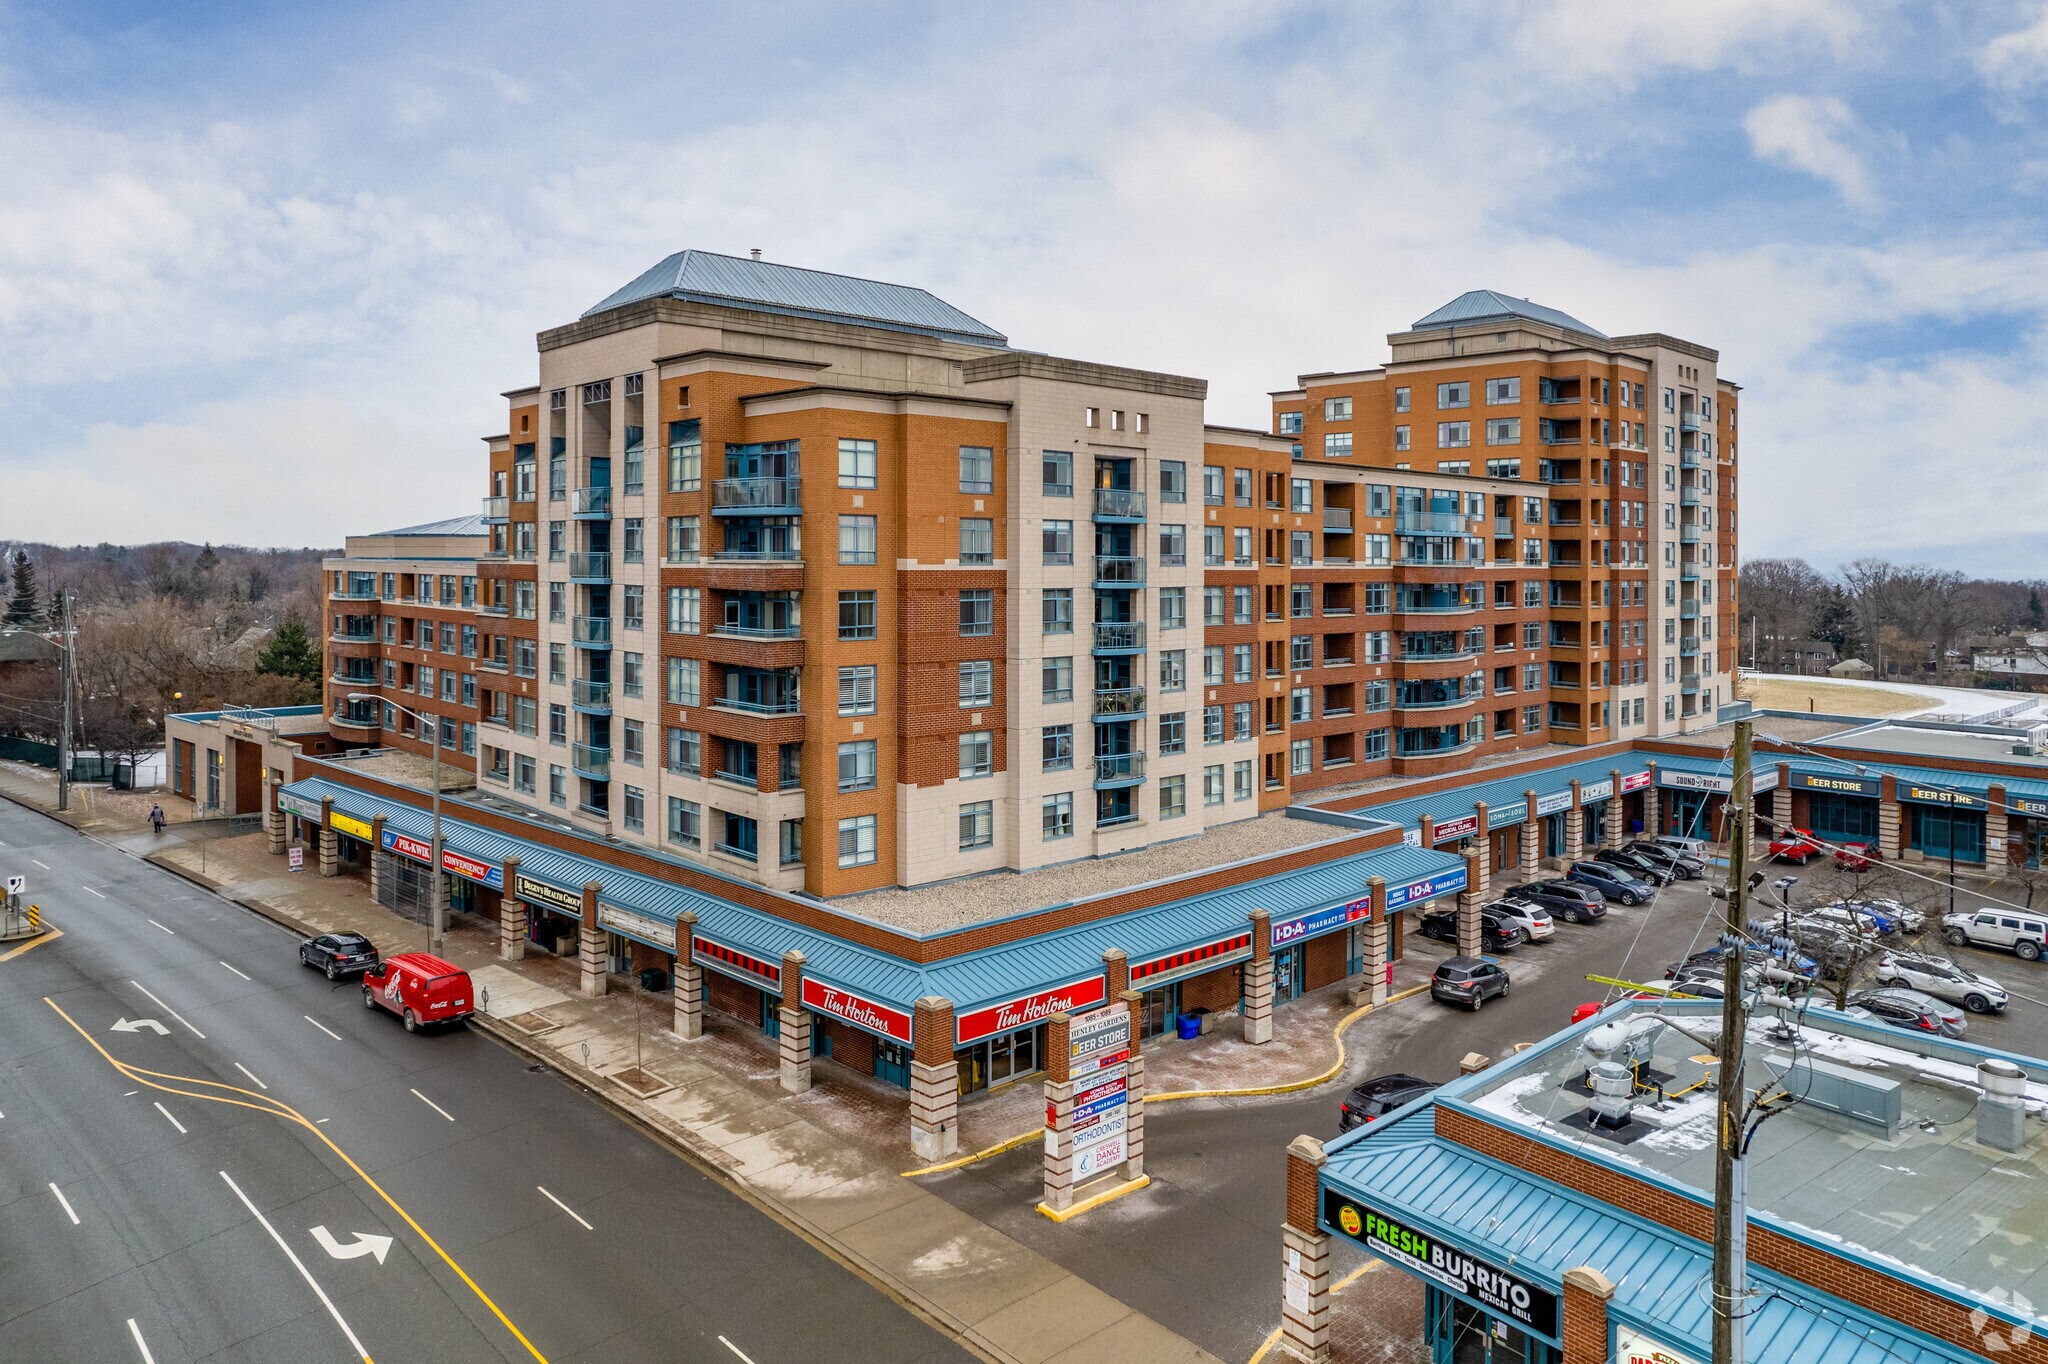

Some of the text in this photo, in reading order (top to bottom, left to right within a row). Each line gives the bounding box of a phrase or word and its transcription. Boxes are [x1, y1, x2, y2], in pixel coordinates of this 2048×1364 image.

[1676, 776, 1720, 789] SOUND RIGHT
[1807, 776, 1862, 791] BEER STORE
[1911, 787, 1938, 799] BEER
[1489, 812, 1505, 822] SOMA
[1511, 808, 1526, 816] SOUL
[2017, 800, 2047, 813] BEER
[1438, 825, 1457, 835] MEDICAL
[1457, 822, 1472, 831] CLINIC
[398, 838, 430, 858] PIK-KWIK
[444, 854, 485, 876] CONVENIENCE
[1435, 877, 1458, 890] PHARMACY
[543, 887, 563, 901] HEALTH
[563, 894, 581, 907] GROUP
[1308, 915, 1338, 931] PHARMACY
[823, 988, 889, 1032] Tim Hortons
[996, 995, 1072, 1030] Tim Hortons
[1071, 1014, 1128, 1038] HENLEY GARDENS
[1072, 1028, 1127, 1056] BEER STORE
[1083, 1083, 1124, 1103] PHYSIOTHERAPY
[1095, 1097, 1119, 1111] PHARMACY
[1073, 1117, 1126, 1146] ORTHODONTIST
[1096, 1139, 1121, 1153] CRESWELL
[1096, 1145, 1121, 1161] DANCE
[1096, 1153, 1121, 1168] ACADEMY
[1366, 1213, 1530, 1309] FRESH BURRITO
[1369, 1238, 1386, 1251] Burritos
[1388, 1248, 1401, 1258] Bowls
[1404, 1255, 1417, 1267] Tacos
[1419, 1263, 1444, 1280] Quesadillas
[1478, 1289, 1532, 1322] MEXICAN GRILL
